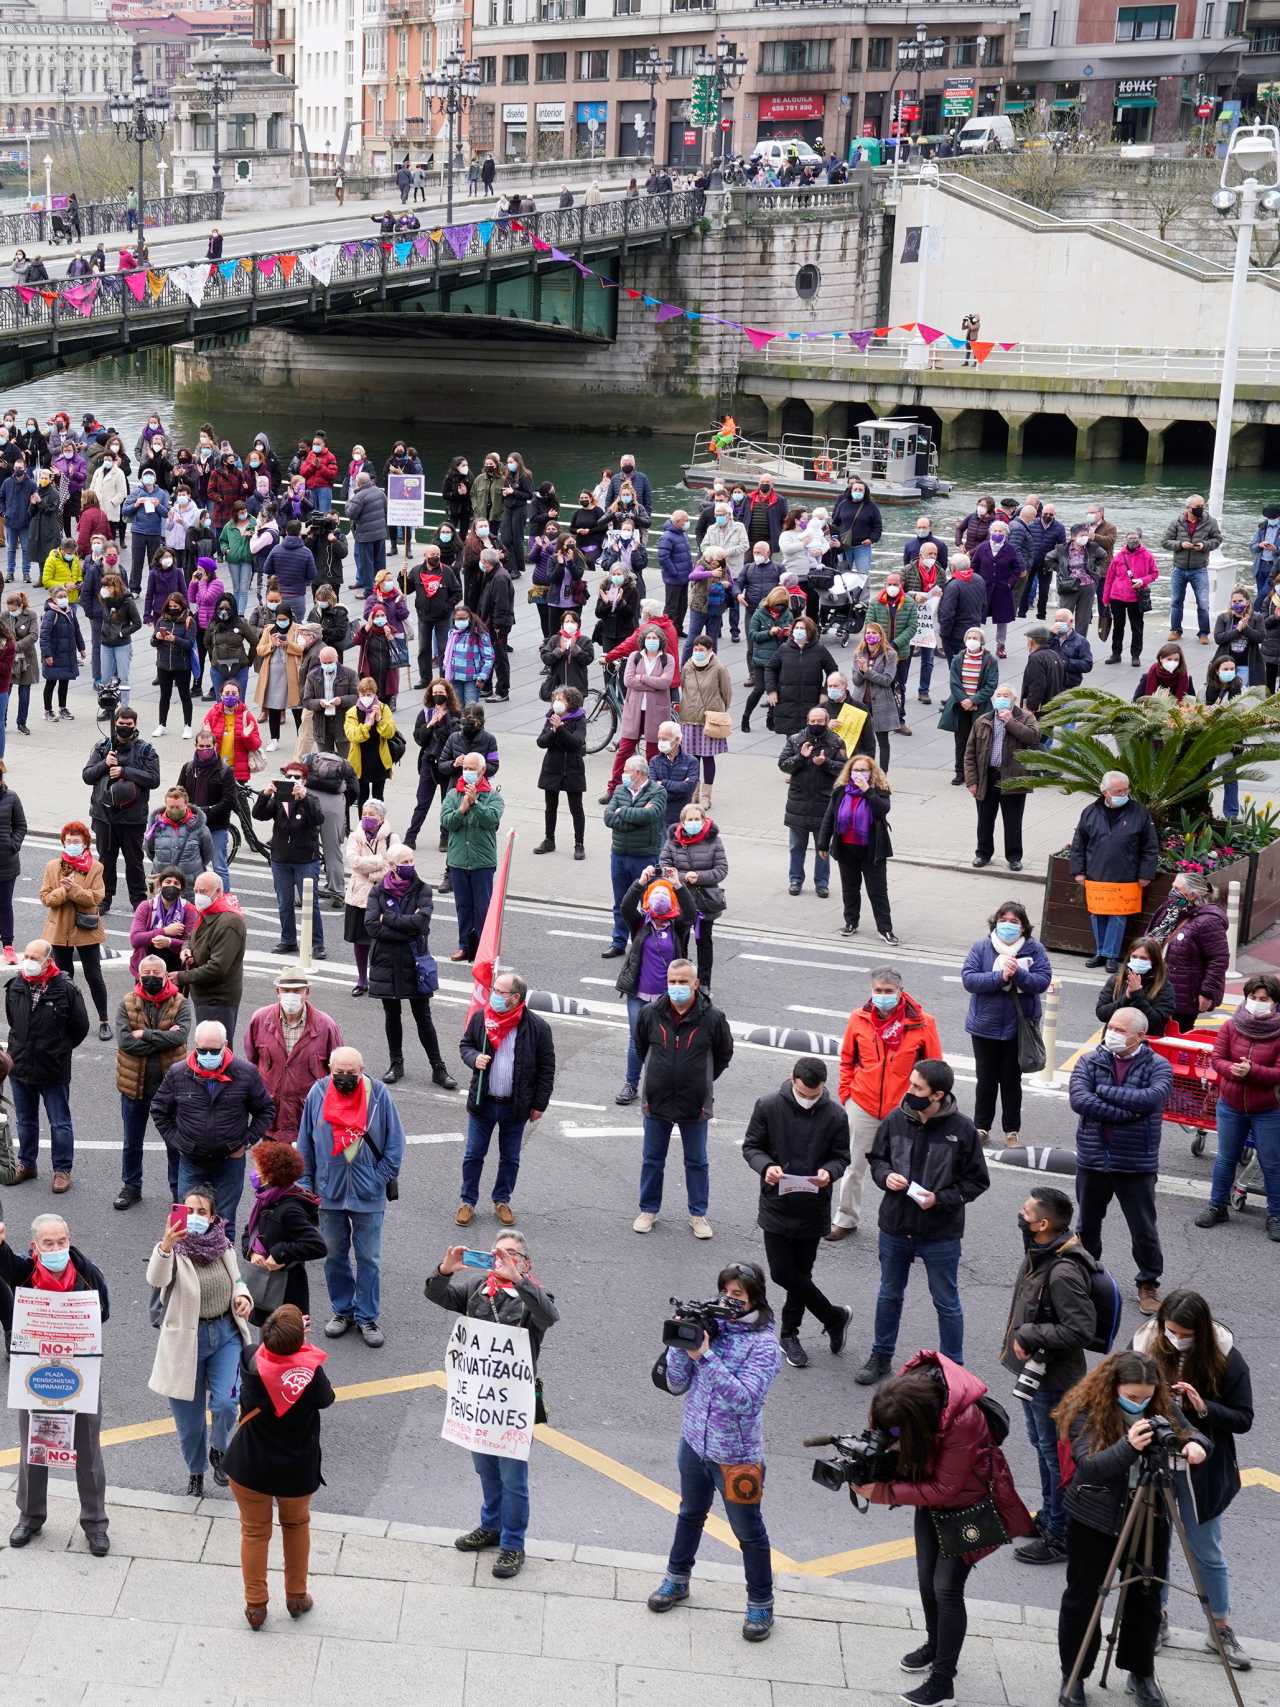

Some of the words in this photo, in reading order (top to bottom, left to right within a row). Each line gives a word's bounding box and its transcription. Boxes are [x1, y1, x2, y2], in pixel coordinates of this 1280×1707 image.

[1119, 80, 1153, 92] KOVAC
[538, 108, 563, 117] interior
[470, 1334, 480, 1351] A
[490, 1337, 515, 1356] LA
[32, 1377, 76, 1385] PENSIONISTAS
[33, 1383, 74, 1391] ENPARANTZA
[477, 1384, 509, 1404] LAS
[450, 1396, 528, 1430] PENSIONES
